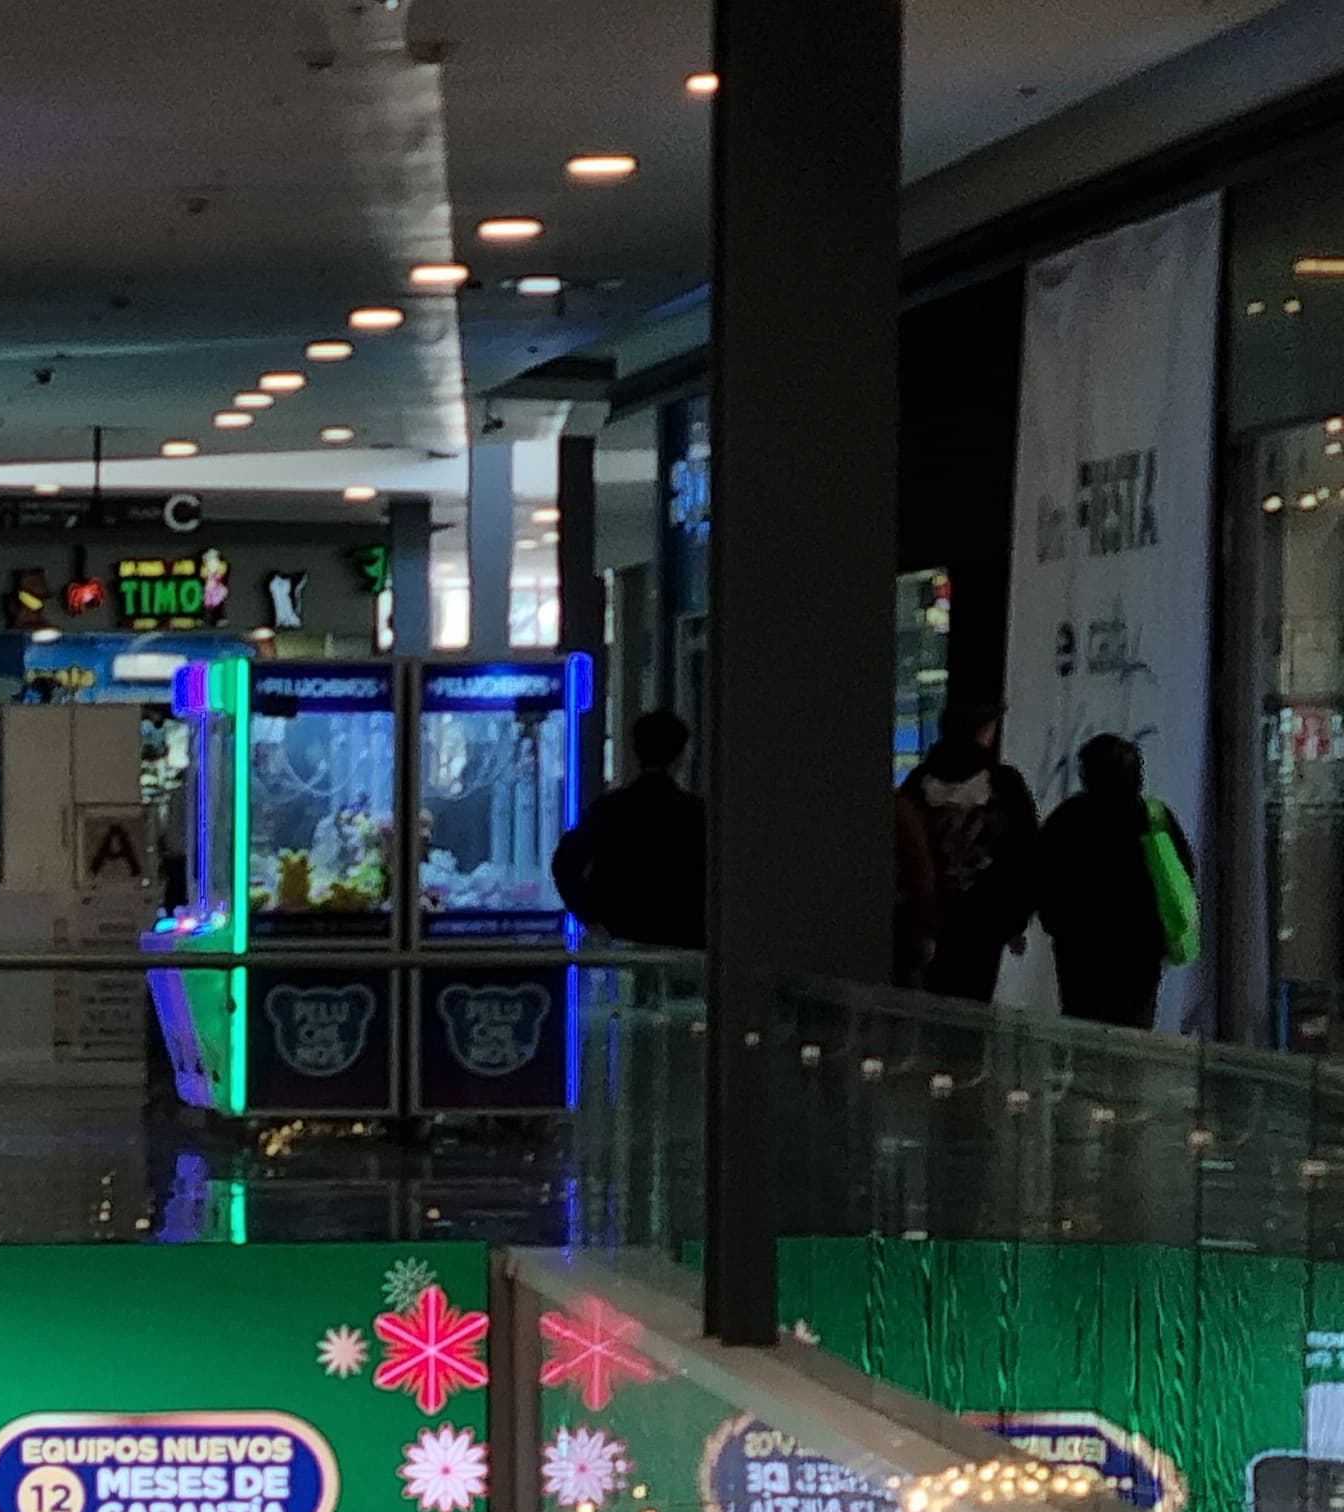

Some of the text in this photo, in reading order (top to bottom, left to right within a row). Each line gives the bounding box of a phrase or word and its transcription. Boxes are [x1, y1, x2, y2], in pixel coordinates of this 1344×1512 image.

[120, 578, 204, 616] TIMO
[21, 1436, 293, 1465] EQUIPOS NUEVOS
[95, 1466, 291, 1500] MESES DE
